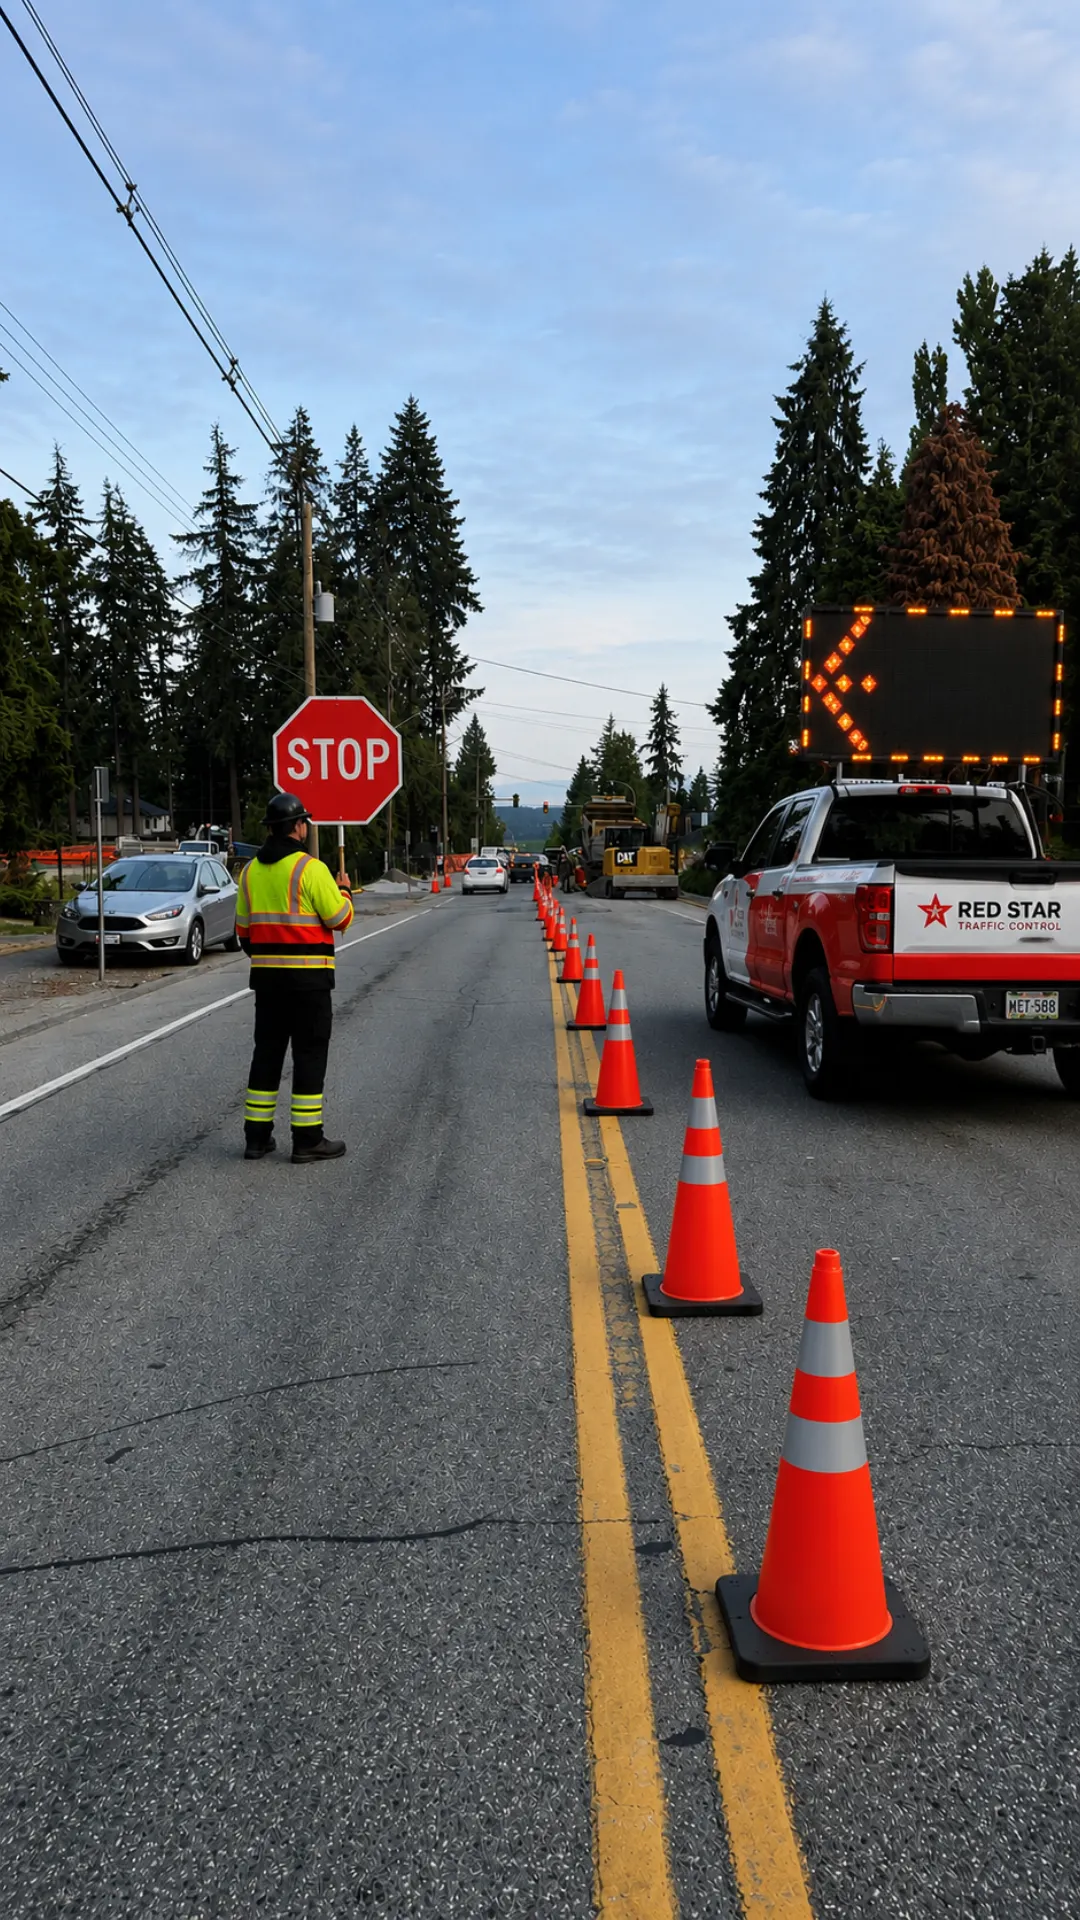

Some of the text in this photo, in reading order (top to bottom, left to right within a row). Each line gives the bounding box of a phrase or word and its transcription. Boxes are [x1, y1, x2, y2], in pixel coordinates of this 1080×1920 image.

[287, 738, 390, 780] STOP
[617, 852, 635, 863] CAT
[958, 901, 1061, 918] RED STAR
[958, 922, 1061, 930] TRAFFIC CONTROL
